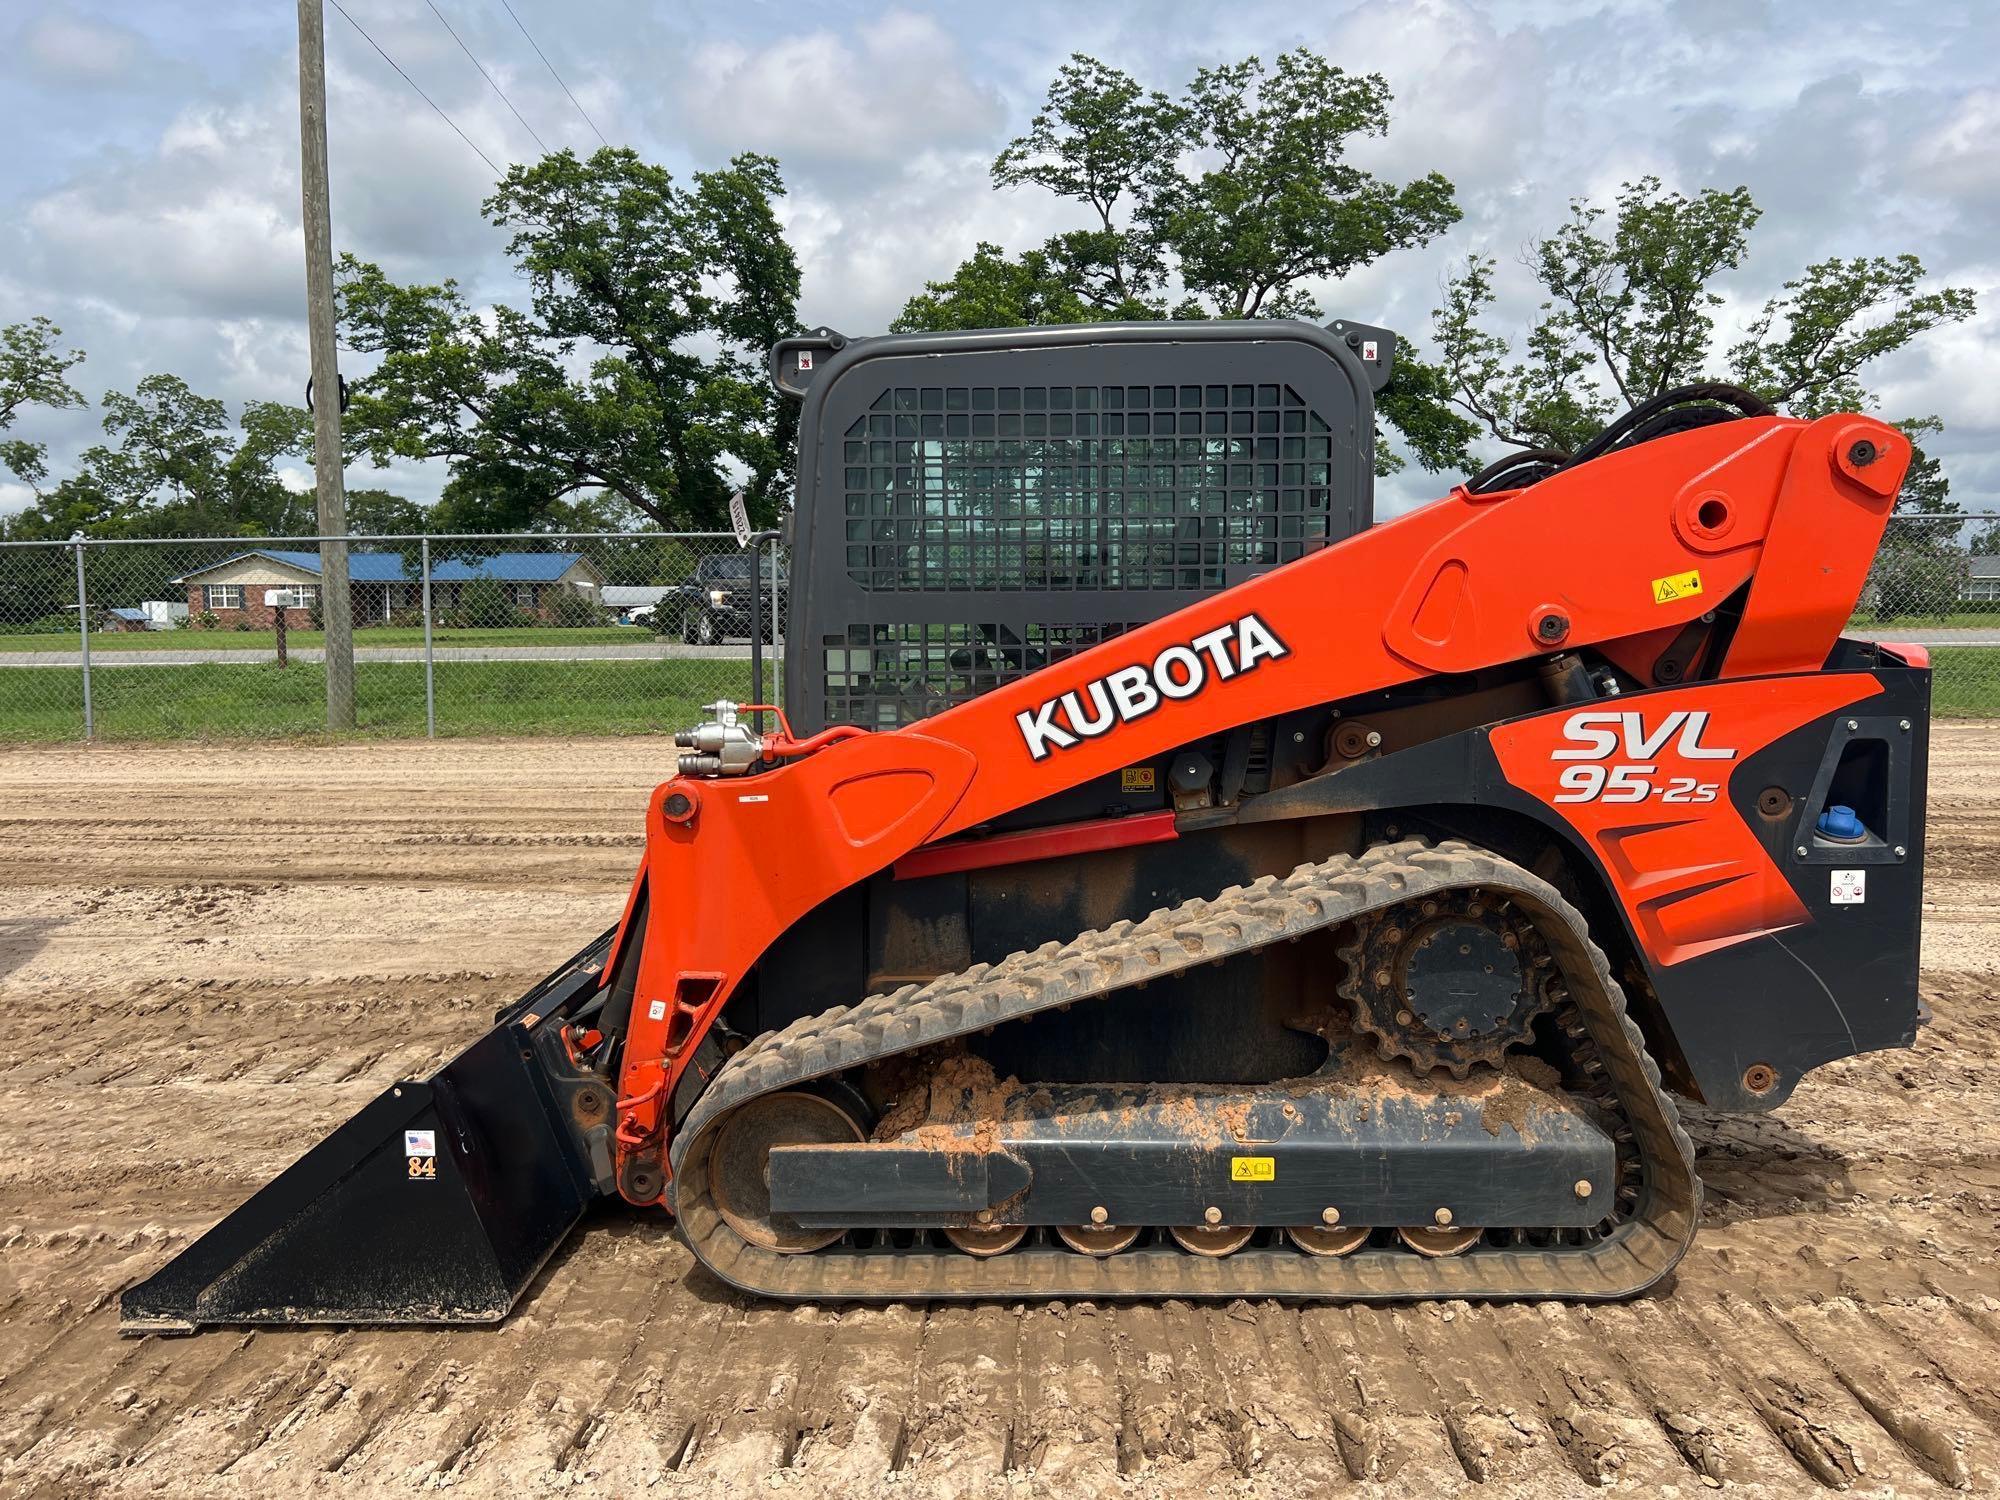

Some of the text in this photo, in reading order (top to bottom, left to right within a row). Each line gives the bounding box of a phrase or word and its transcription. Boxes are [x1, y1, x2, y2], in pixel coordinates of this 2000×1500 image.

[1016, 614, 1288, 760] KUBOTA
[1551, 711, 1738, 760] SVL
[408, 1156, 436, 1177] 84
